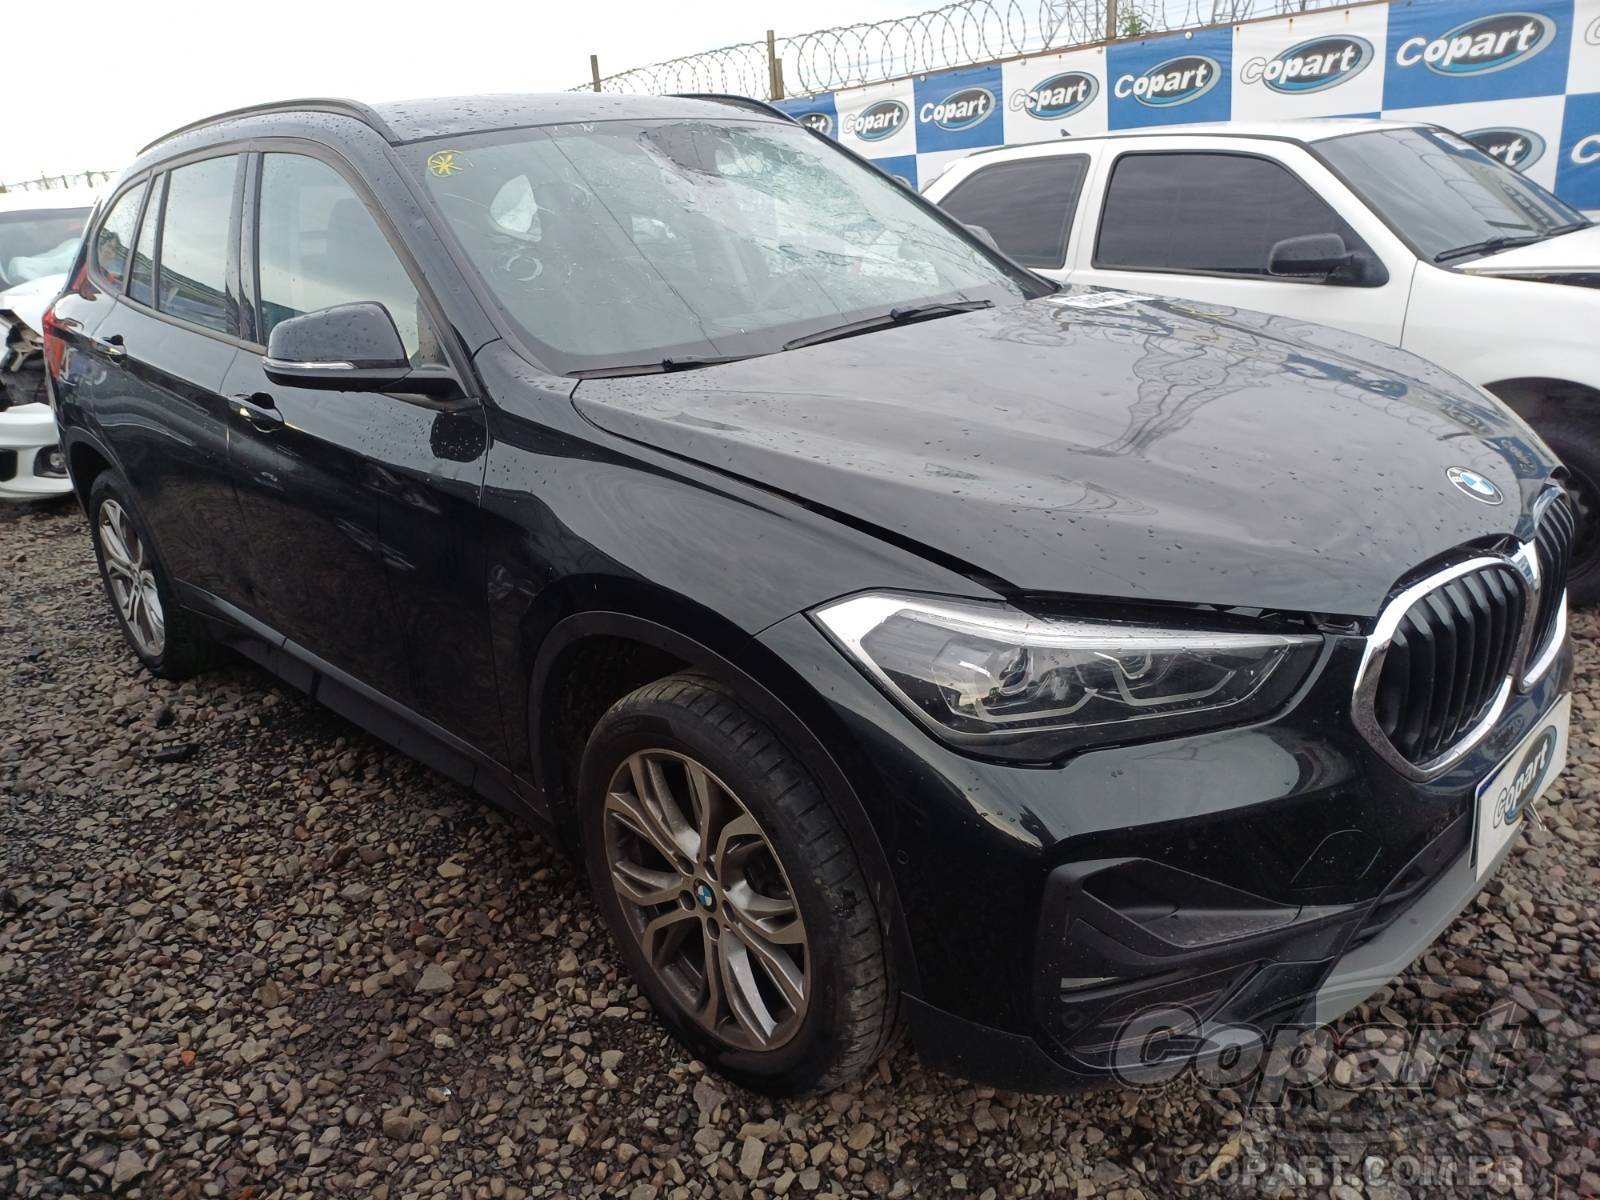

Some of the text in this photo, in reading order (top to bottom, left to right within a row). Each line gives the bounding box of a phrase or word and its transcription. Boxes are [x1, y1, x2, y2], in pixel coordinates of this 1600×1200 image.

[1396, 18, 1537, 67] Copart
[1114, 64, 1210, 98] Copart
[1240, 45, 1356, 85] Copart
[920, 95, 987, 125] Copart
[1009, 79, 1087, 112] Copart
[842, 108, 900, 135] Copart
[1493, 738, 1548, 829] Copart
